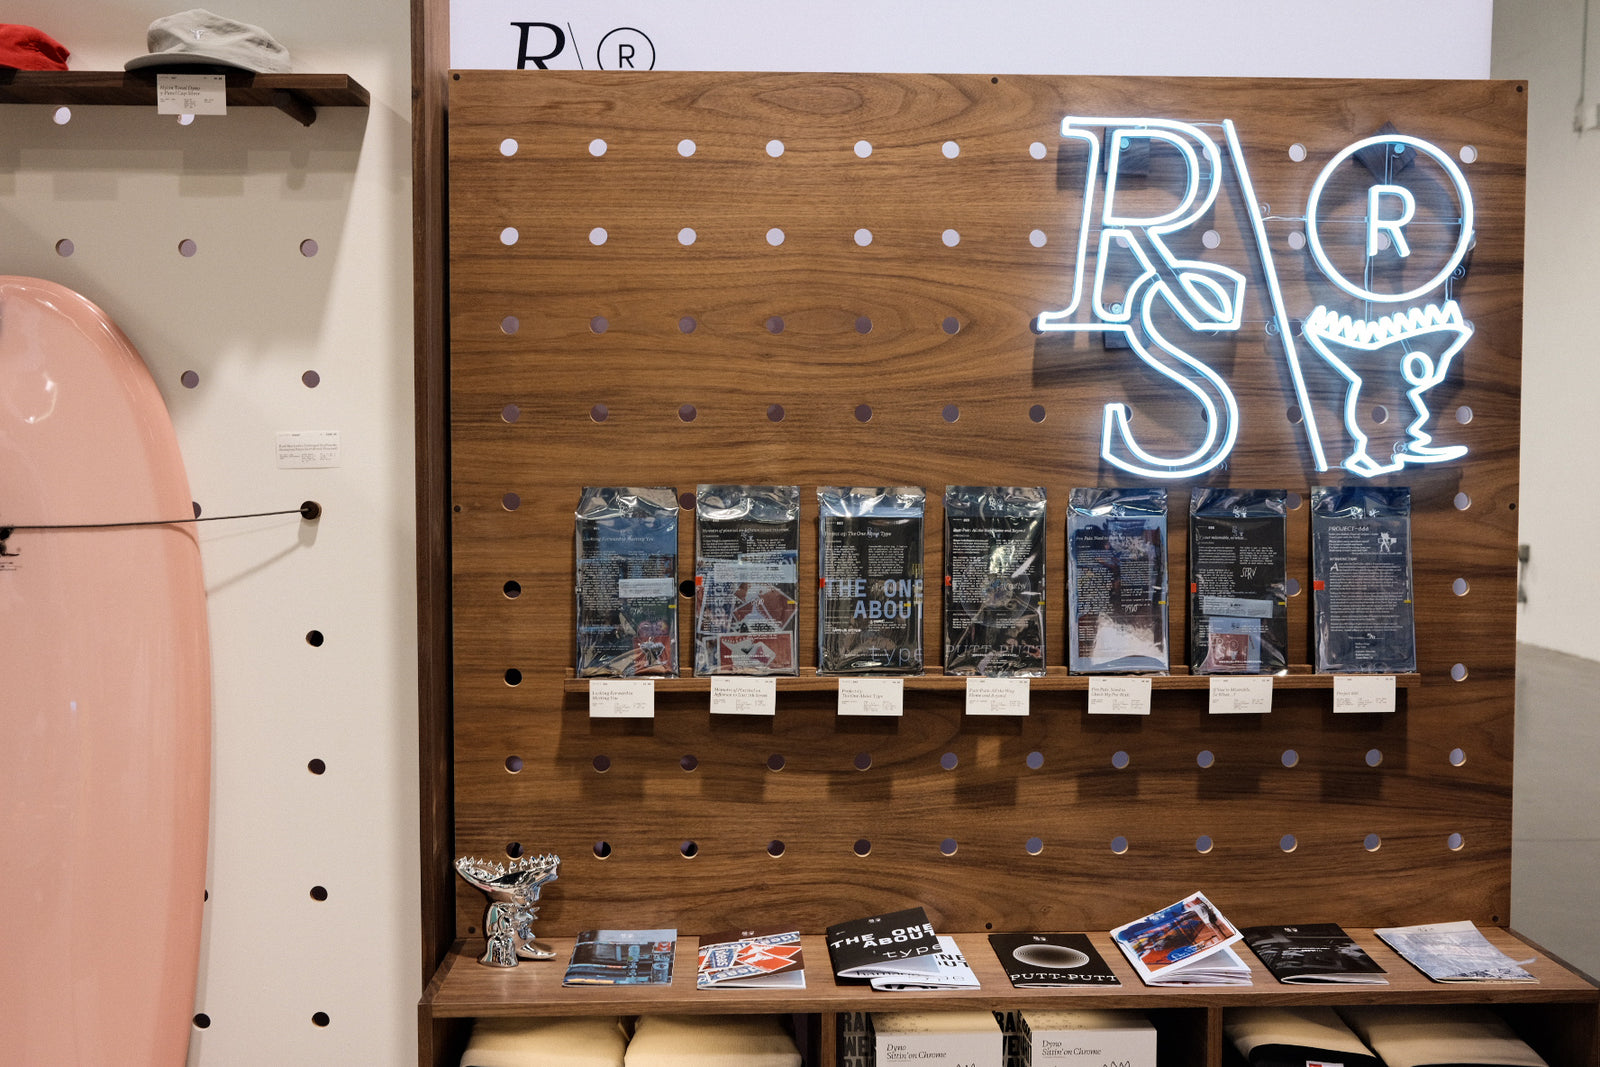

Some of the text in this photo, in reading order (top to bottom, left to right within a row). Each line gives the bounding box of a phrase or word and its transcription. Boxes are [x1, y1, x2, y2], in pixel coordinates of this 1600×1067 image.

[825, 579, 867, 597] THE
[830, 922, 932, 949] THE ONE
[1010, 973, 1117, 981] PUTT-PUTT
[886, 1043, 907, 1053] Dyno
[1042, 1039, 1062, 1049] Dyno
[918, 1050, 947, 1059] Chrome
[1073, 1047, 1102, 1056] Chrome
